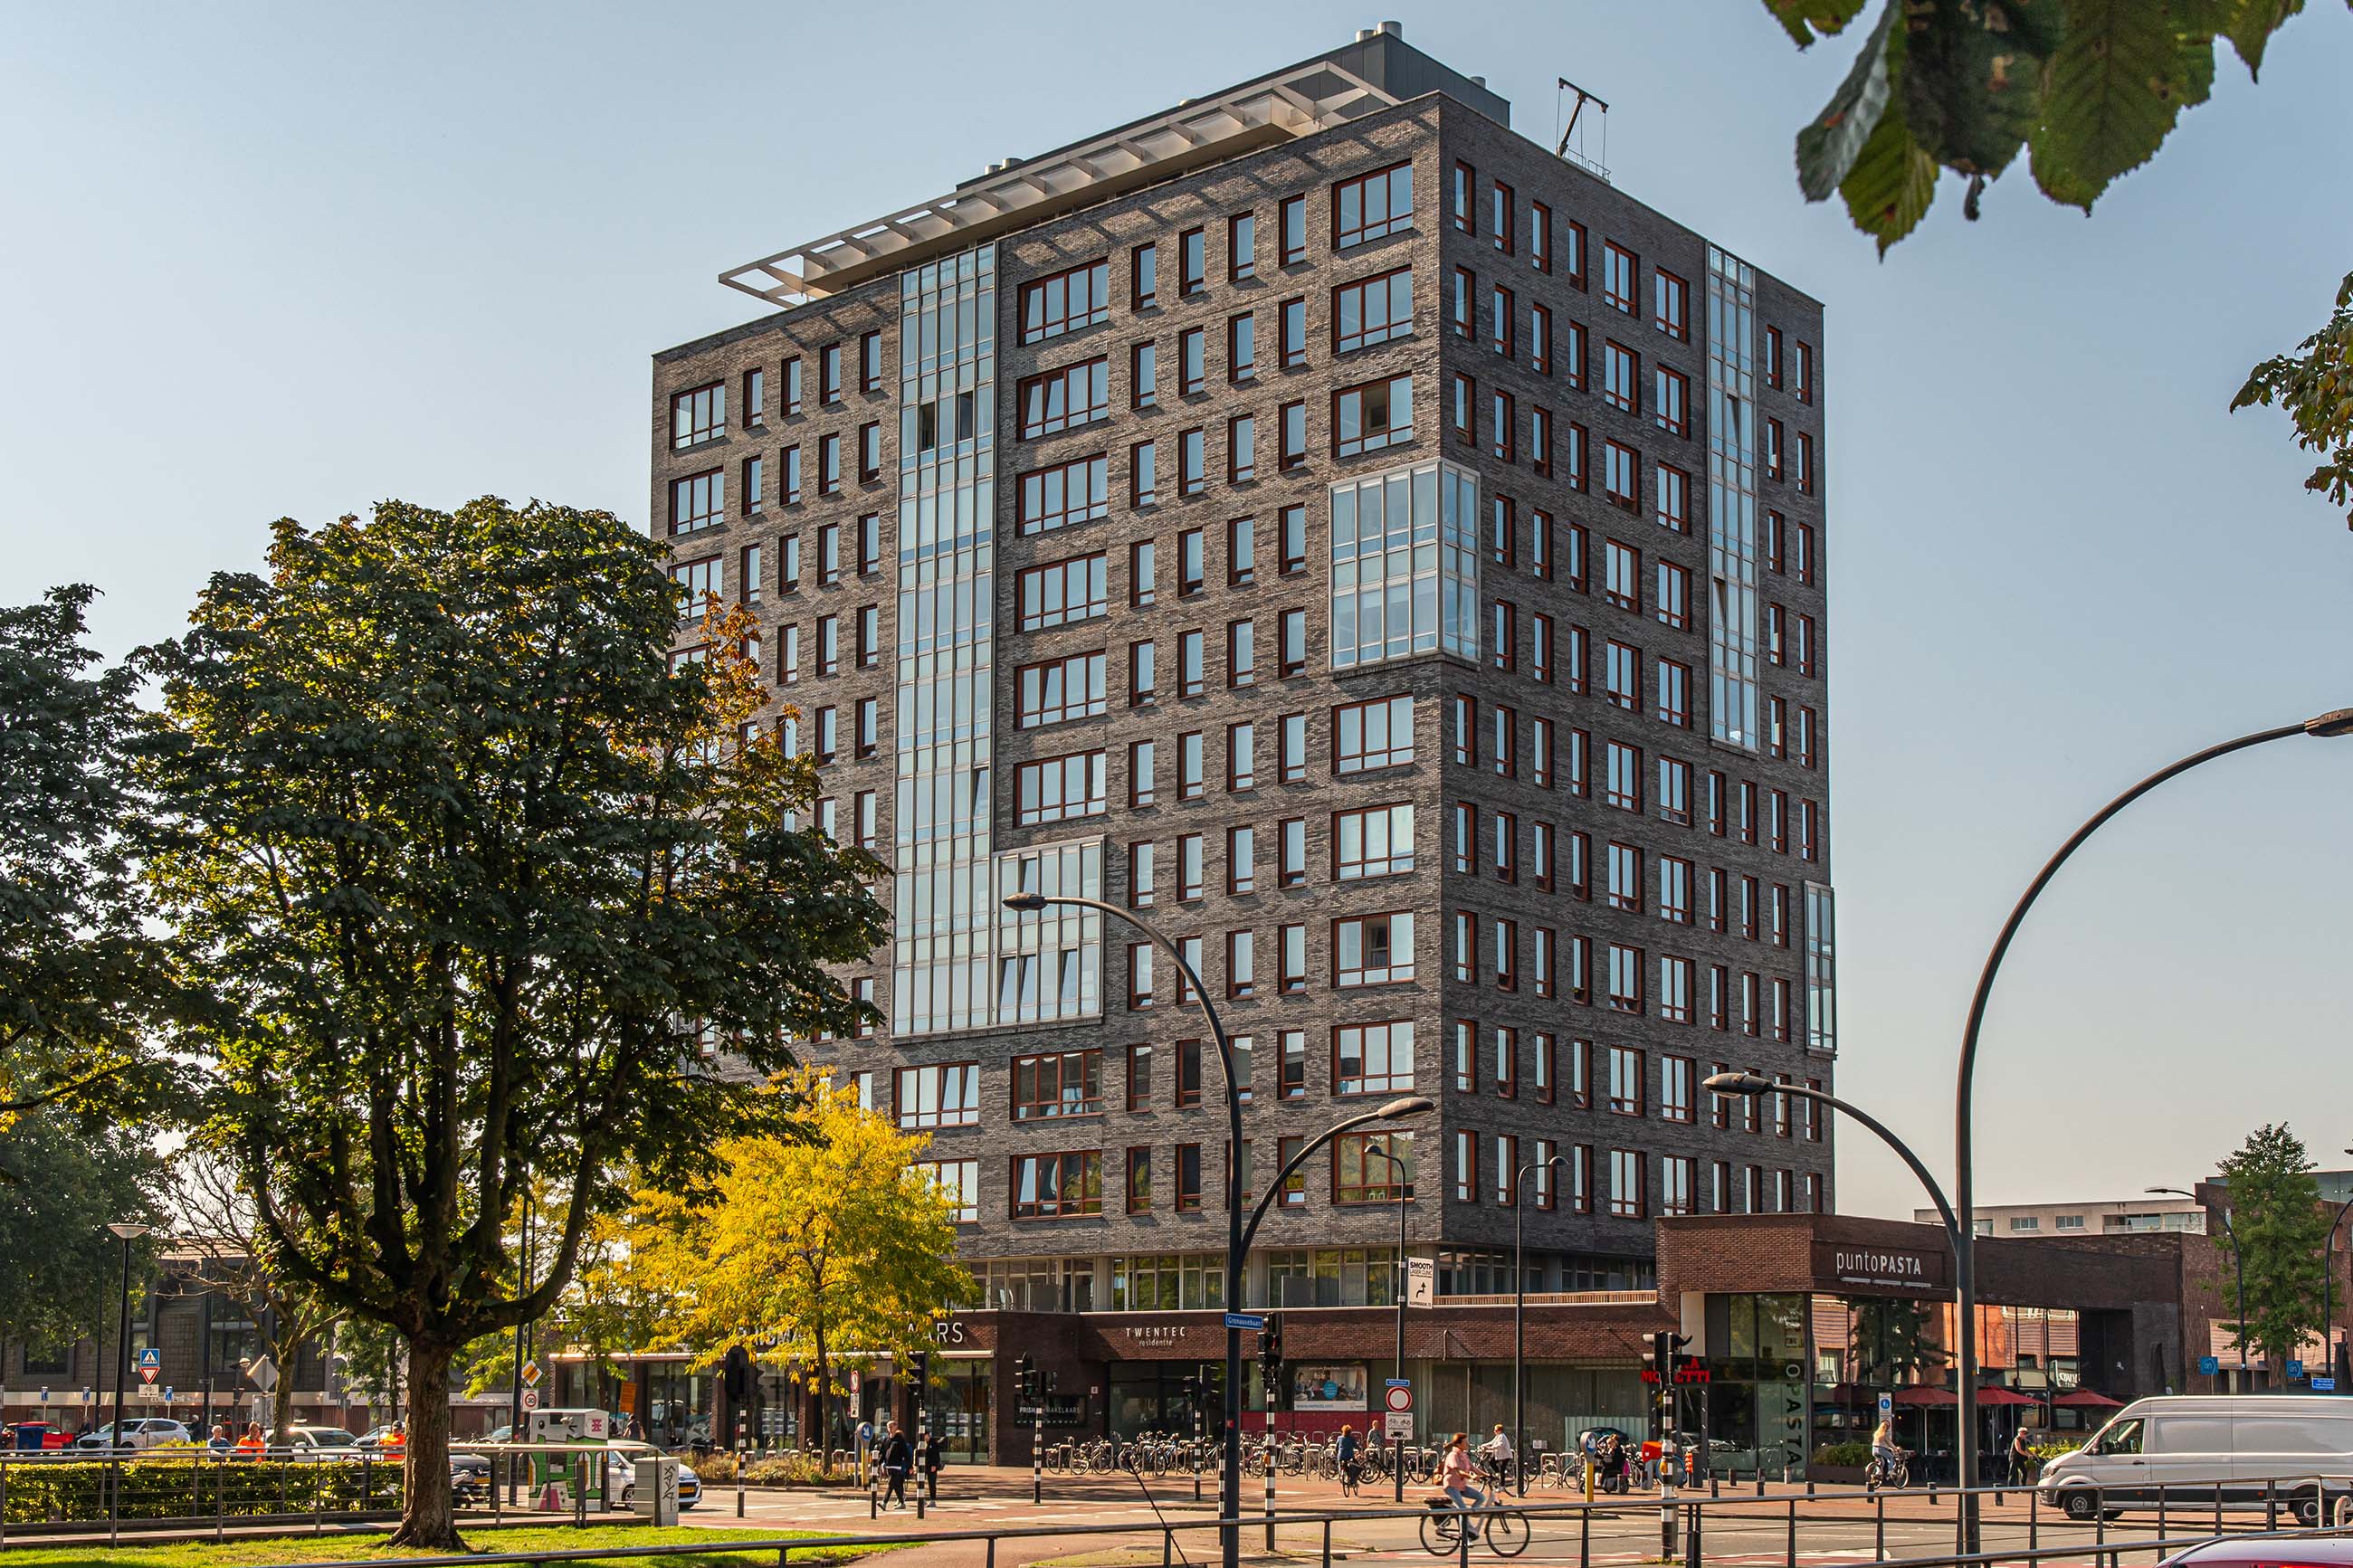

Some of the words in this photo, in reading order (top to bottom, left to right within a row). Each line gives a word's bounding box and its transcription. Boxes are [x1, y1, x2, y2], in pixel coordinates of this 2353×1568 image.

[1410, 1261, 1434, 1270] SMOOTH
[1836, 1251, 1921, 1275] puntoPASTA
[1126, 1326, 1186, 1337] TWENTEC
[1138, 1339, 1173, 1347] residentie
[1641, 1370, 1710, 1383] MOETTI
